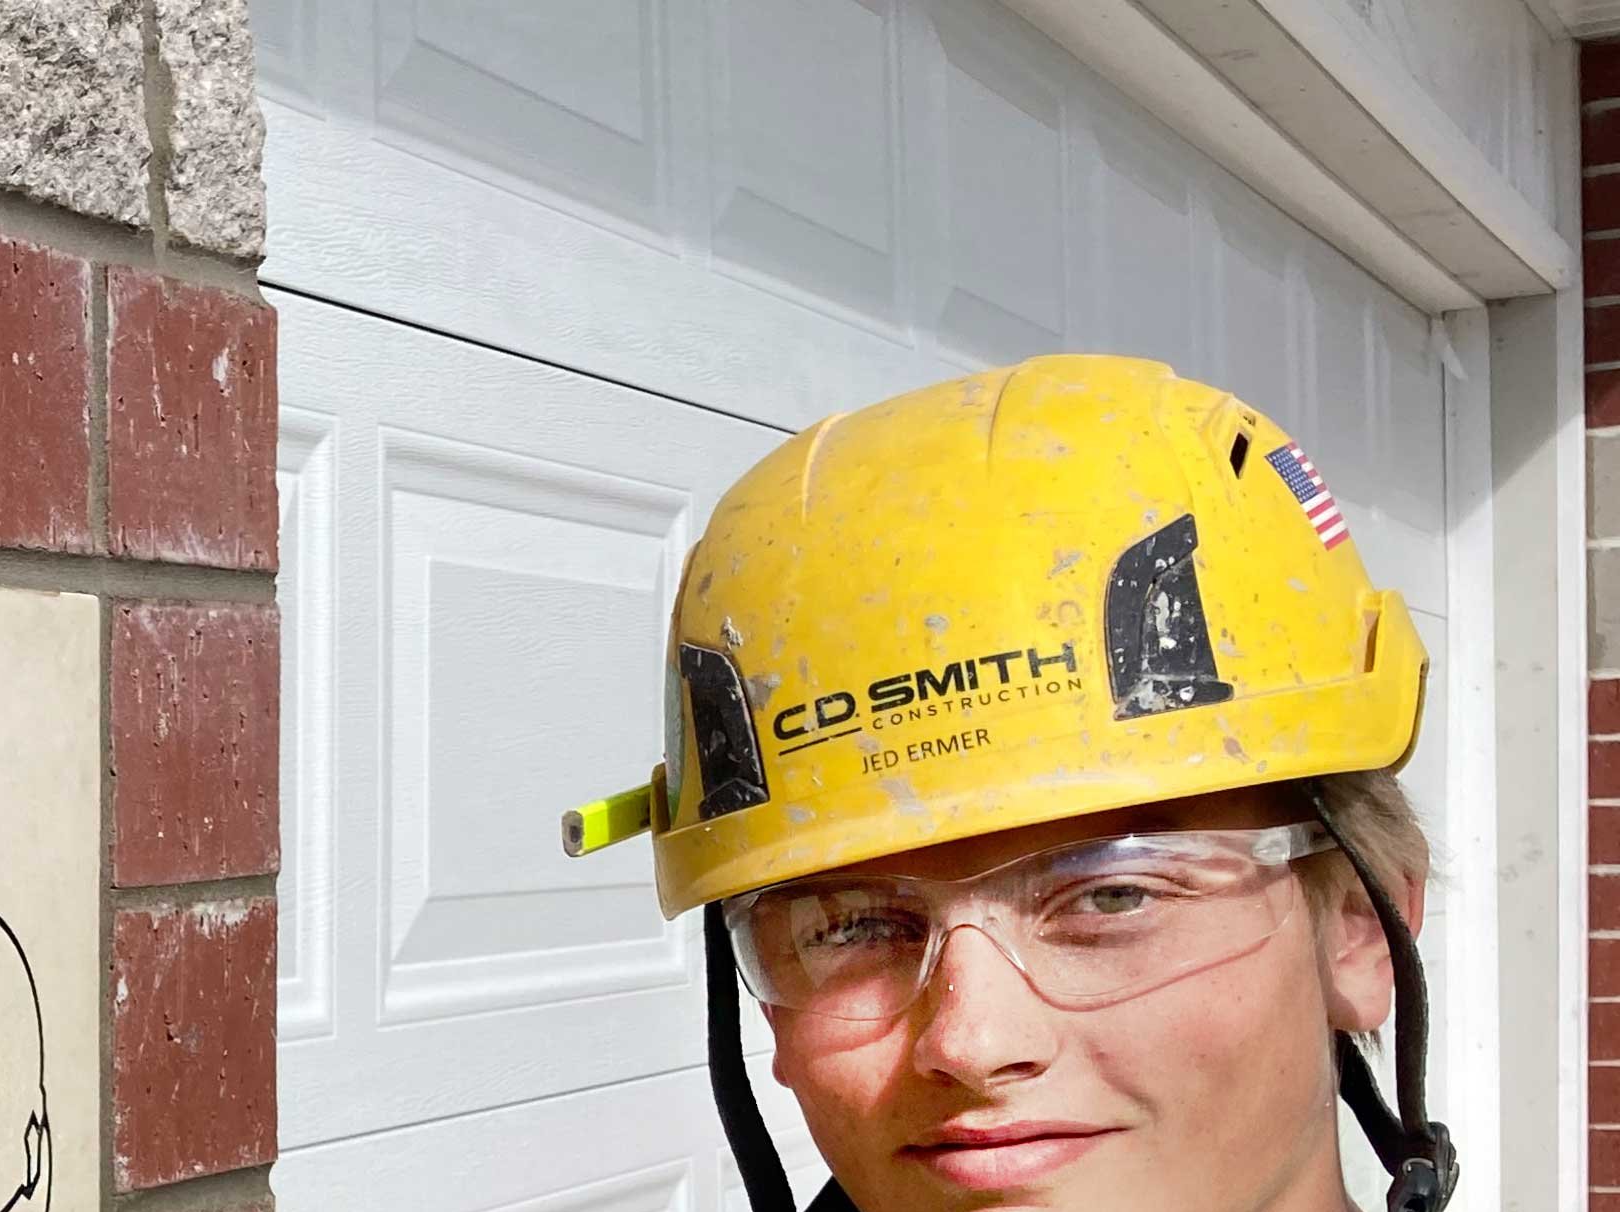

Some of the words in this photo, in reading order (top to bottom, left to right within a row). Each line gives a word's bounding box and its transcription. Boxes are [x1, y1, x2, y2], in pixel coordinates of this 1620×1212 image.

[867, 640, 1078, 715] SMITH
[871, 677, 1083, 731] CONSTRUCTION
[861, 749, 900, 775] JED
[906, 728, 992, 763] ERMER
